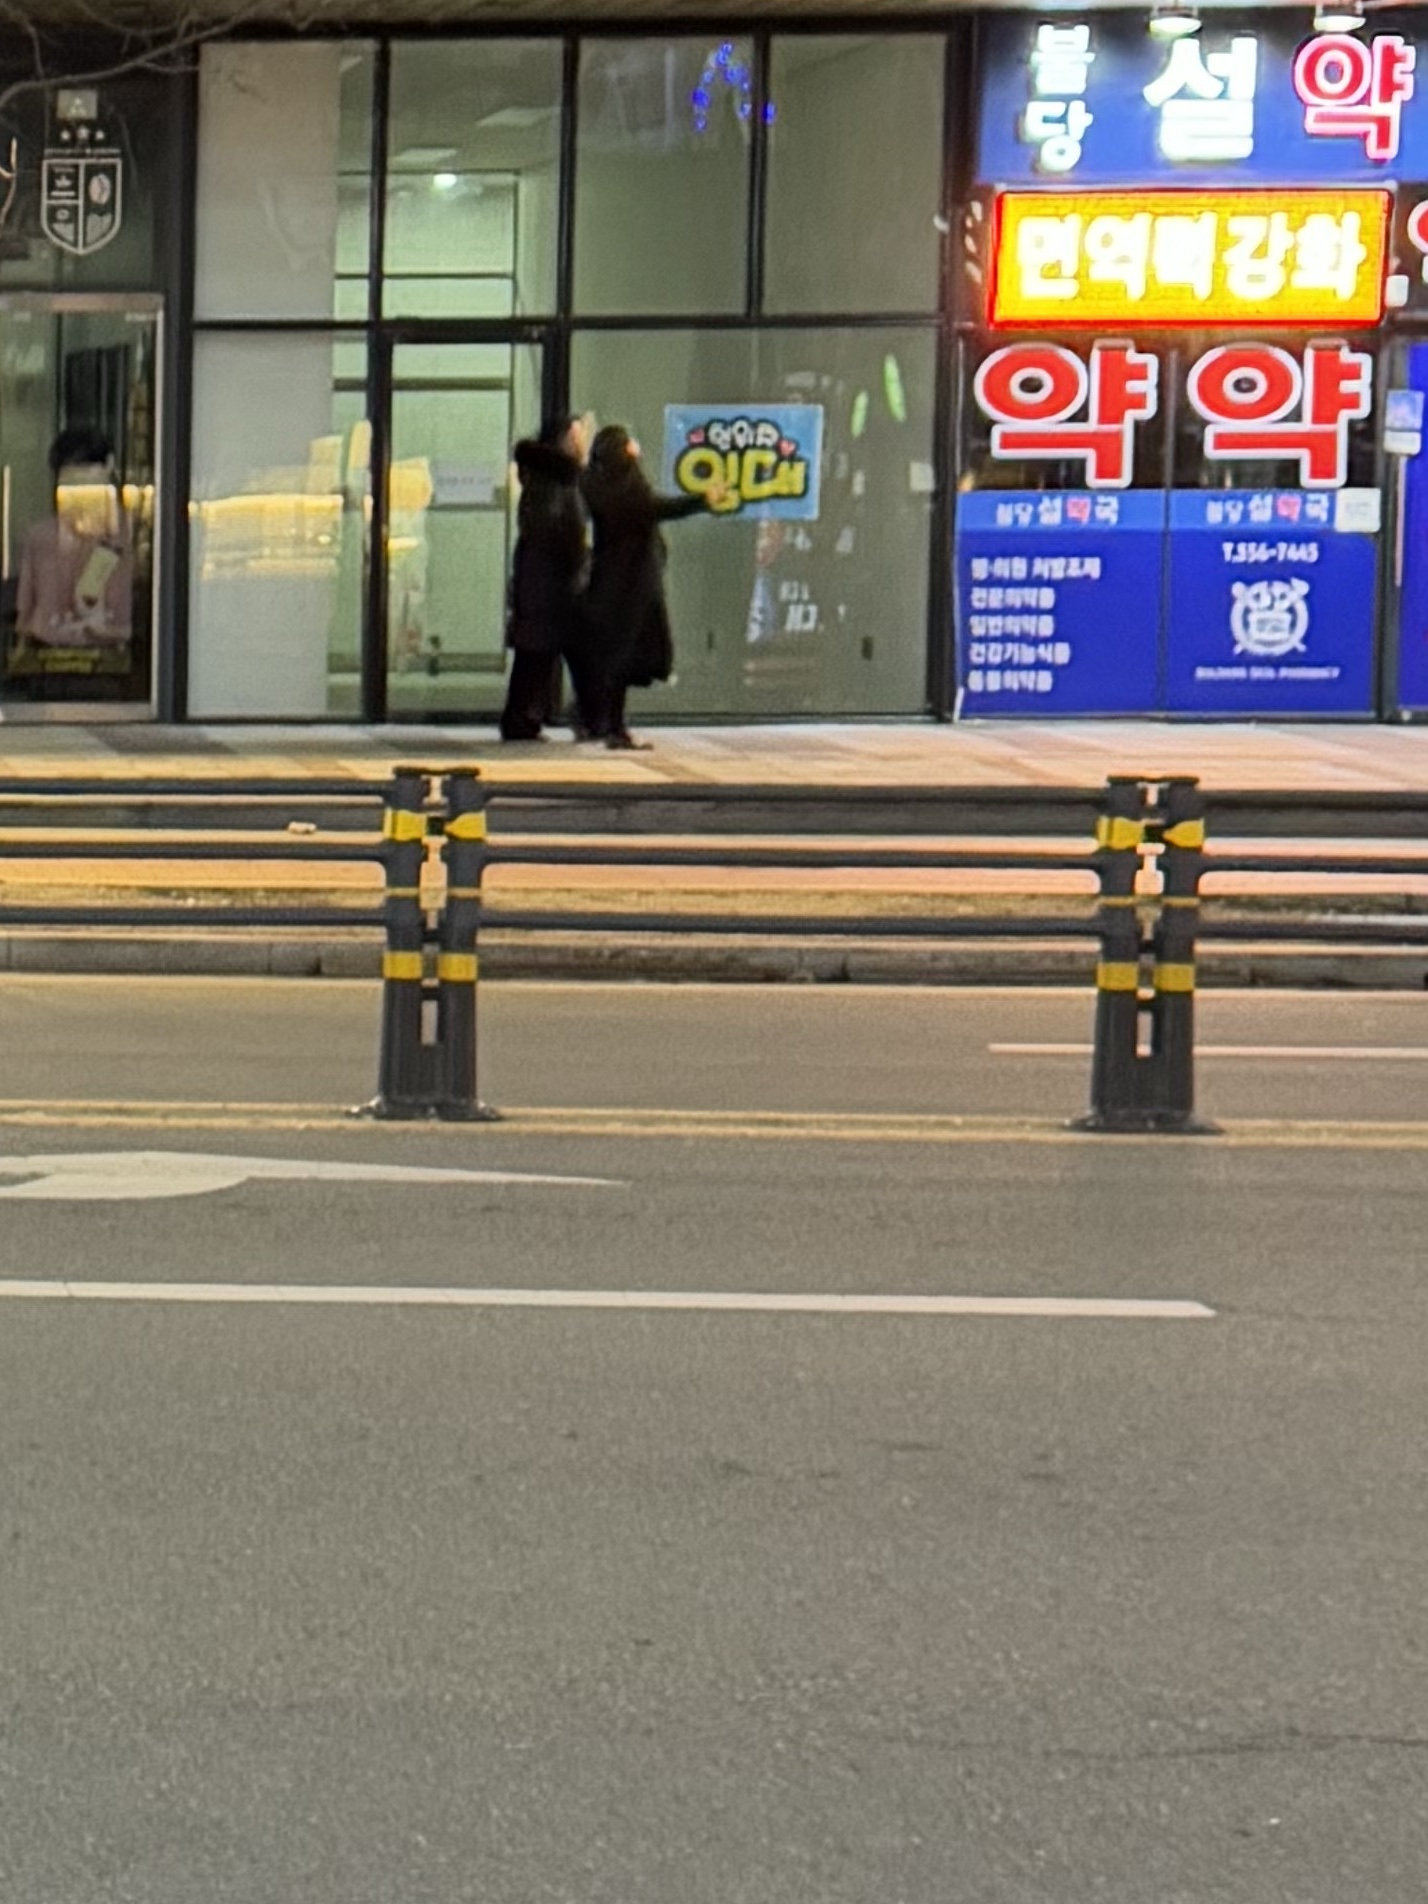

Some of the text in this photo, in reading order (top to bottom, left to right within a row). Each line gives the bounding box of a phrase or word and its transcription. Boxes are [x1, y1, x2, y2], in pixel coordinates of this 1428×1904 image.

[1021, 24, 1095, 172] 불당
[974, 338, 1158, 487] 약
[1187, 338, 1372, 487] 약
